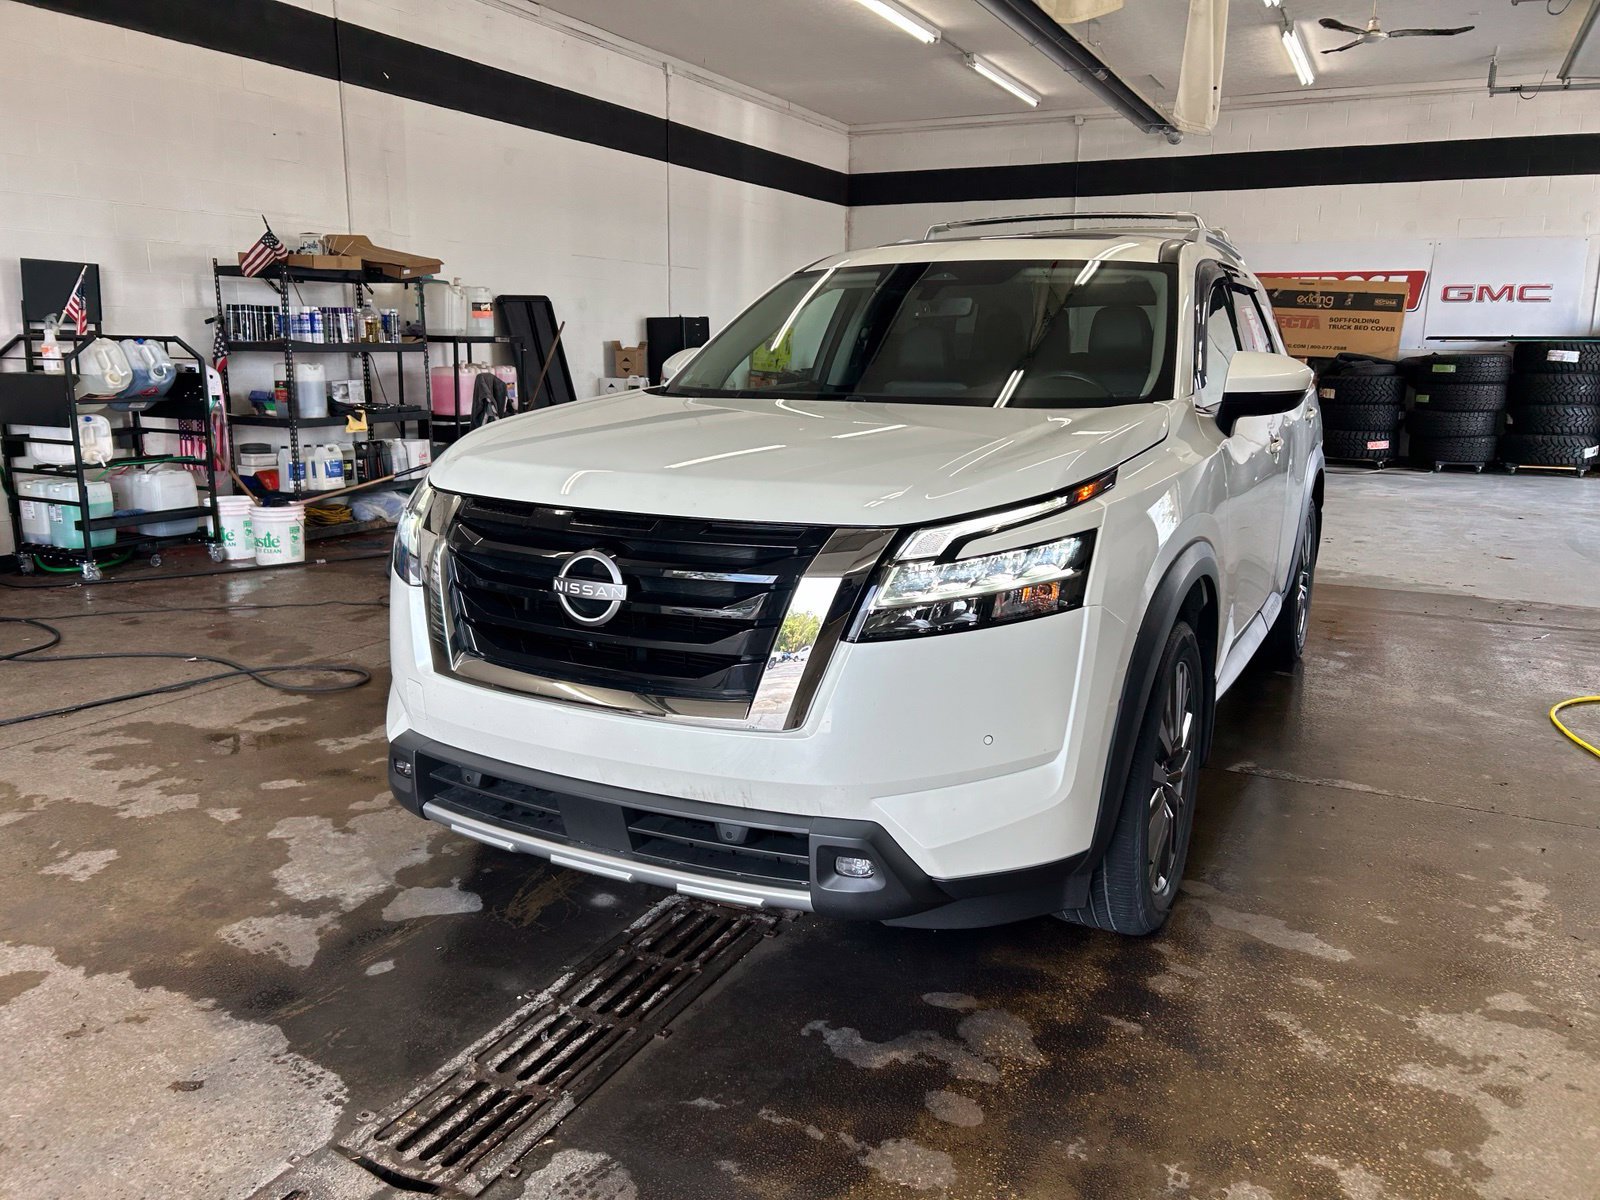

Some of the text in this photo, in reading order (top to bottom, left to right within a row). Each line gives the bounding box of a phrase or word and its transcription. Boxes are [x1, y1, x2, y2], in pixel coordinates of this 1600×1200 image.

[1441, 284, 1553, 303] GMC
[1370, 325, 1396, 333] COVER
[553, 579, 624, 598] NISSAN
